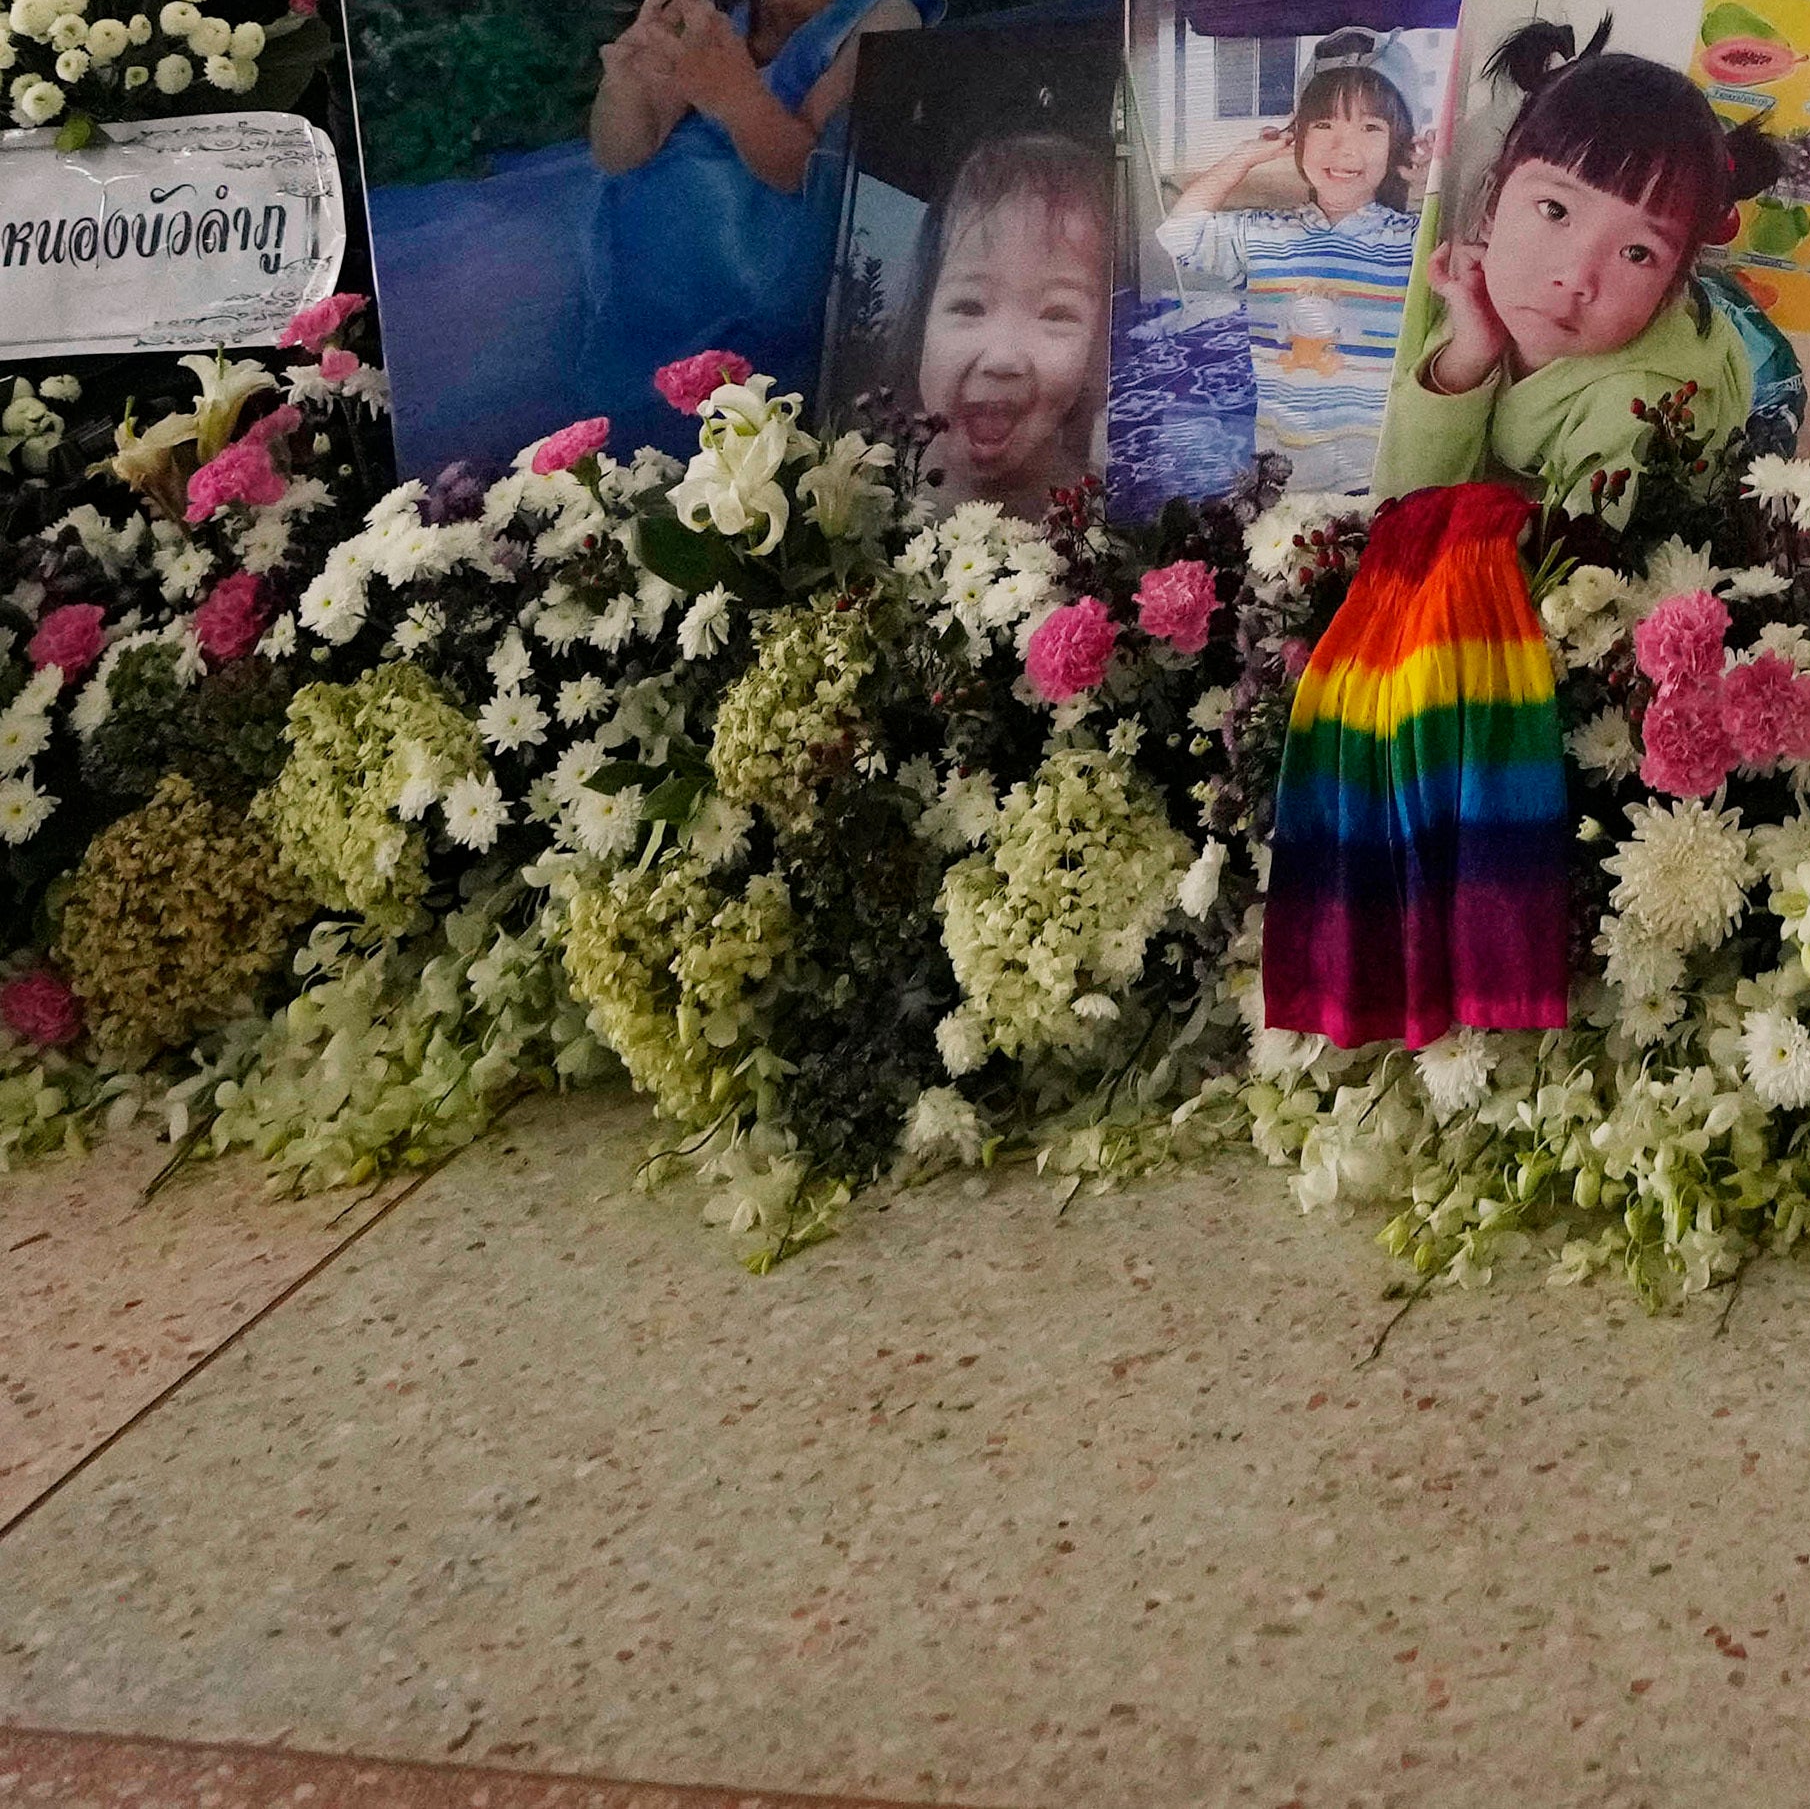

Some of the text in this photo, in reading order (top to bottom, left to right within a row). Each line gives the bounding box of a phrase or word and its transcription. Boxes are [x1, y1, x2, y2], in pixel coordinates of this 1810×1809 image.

[2, 183, 287, 275] หนองบัวลำภู
